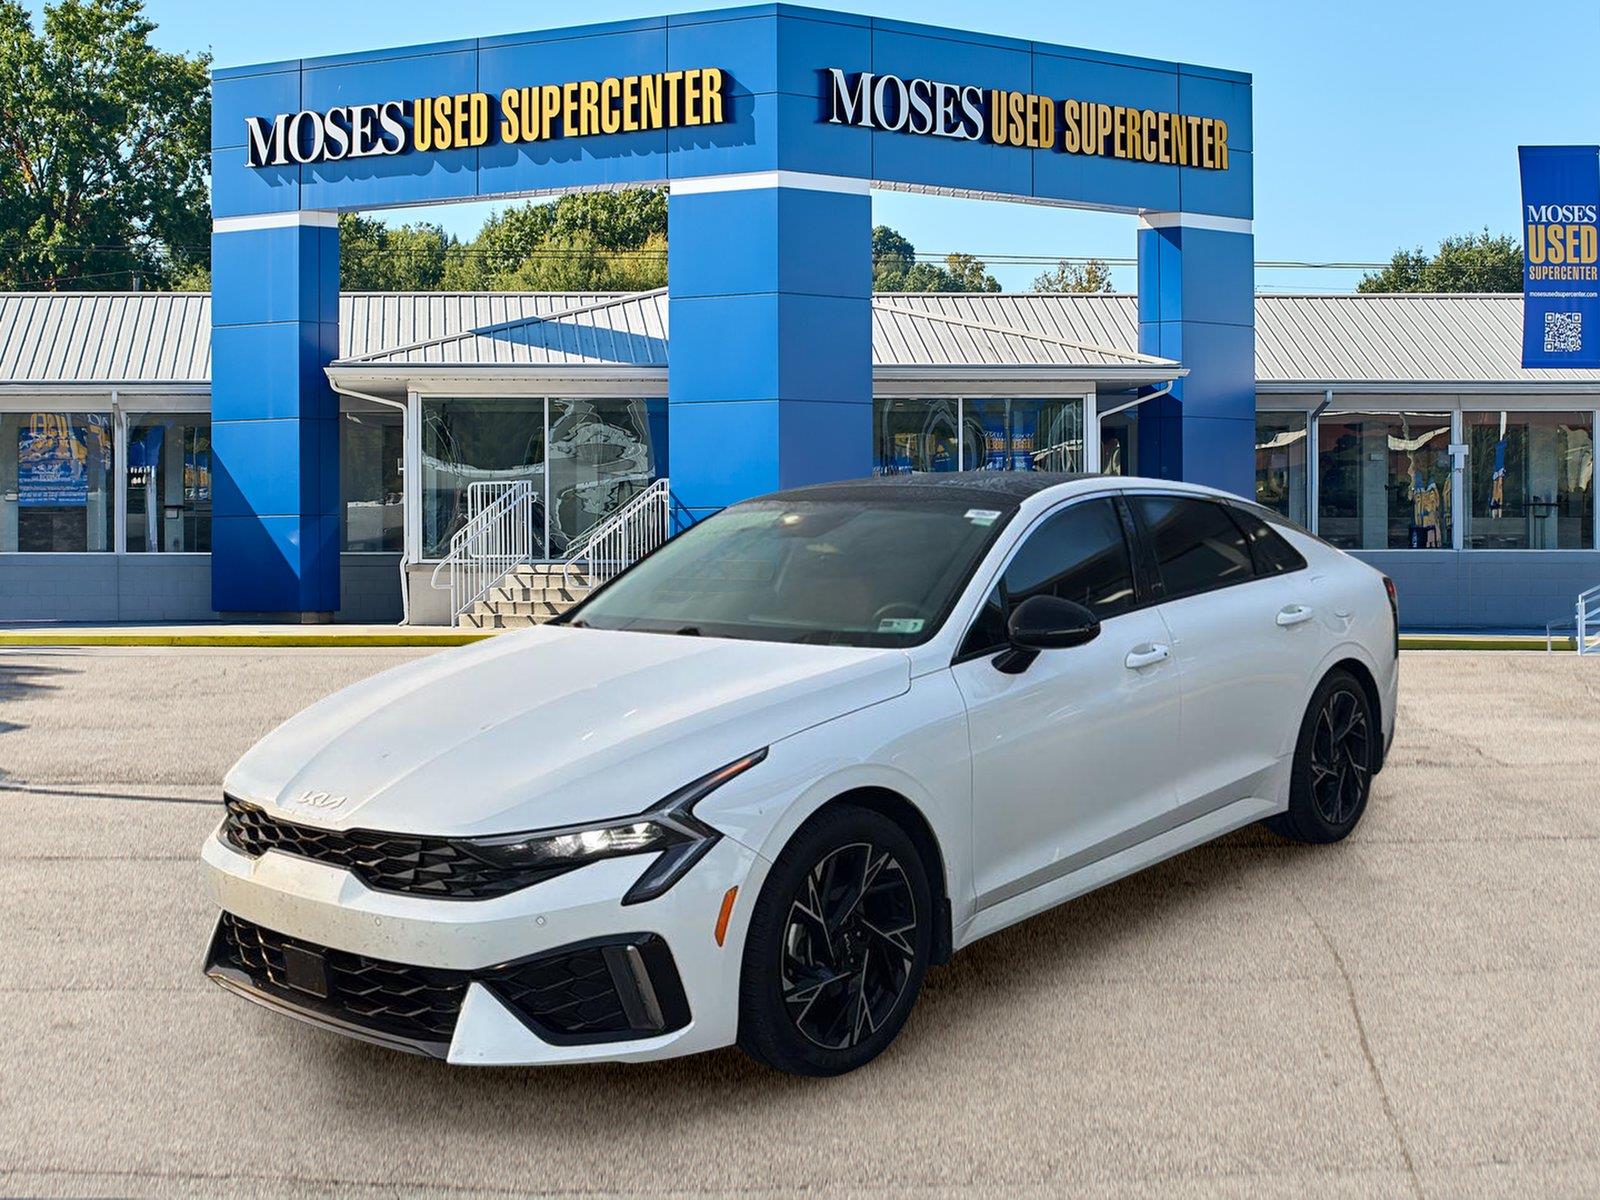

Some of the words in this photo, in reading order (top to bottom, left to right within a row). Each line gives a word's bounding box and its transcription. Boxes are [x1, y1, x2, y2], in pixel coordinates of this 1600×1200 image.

[244, 100, 408, 168] MOSES
[412, 92, 489, 152] USED
[500, 67, 726, 144] SUPERCENTER
[829, 67, 984, 142] MOSES
[990, 89, 1054, 150] USED
[1064, 98, 1229, 171] SUPERCENTER
[1527, 204, 1597, 223] MOSES
[1528, 224, 1597, 264] USED
[1529, 266, 1597, 280] SUPERCENTER
